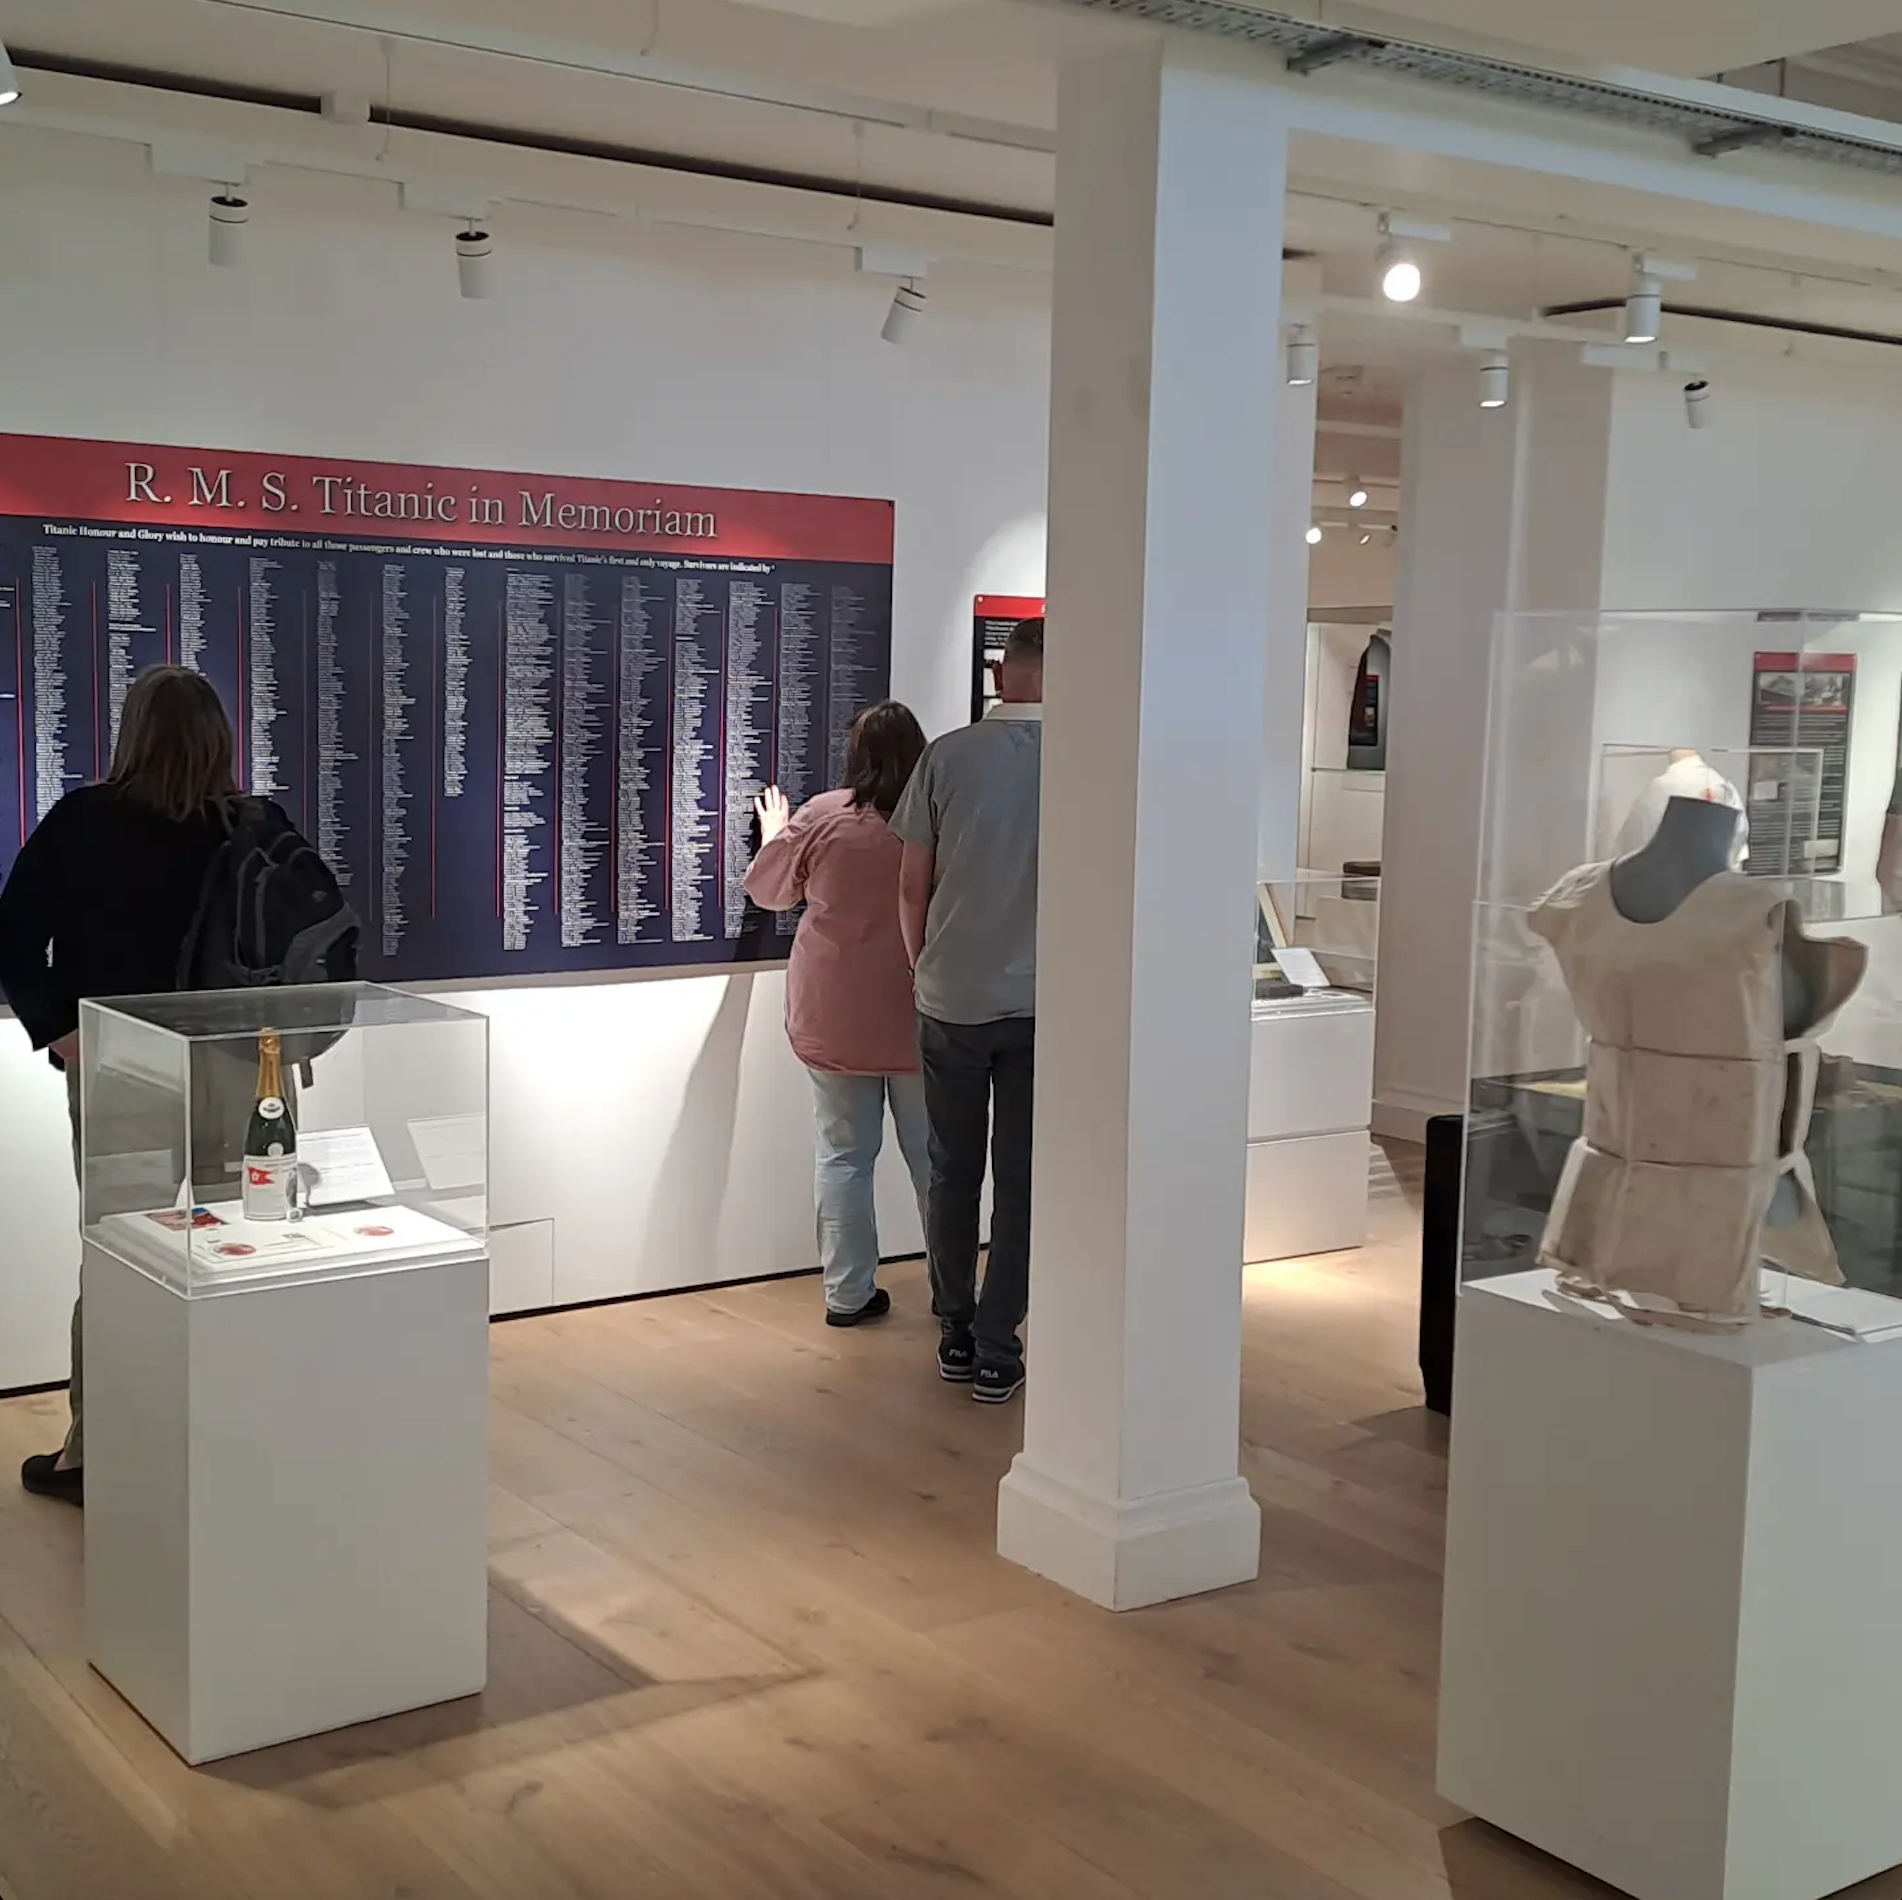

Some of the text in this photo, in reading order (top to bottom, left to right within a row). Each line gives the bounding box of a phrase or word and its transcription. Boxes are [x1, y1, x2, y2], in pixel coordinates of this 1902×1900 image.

[125, 462, 719, 538] R. M. S. Titanic in Memoriam
[43, 524, 78, 536] Titanic
[79, 526, 117, 538] Honour
[118, 529, 136, 539] and
[138, 529, 164, 542] Glory
[166, 531, 187, 541] wish
[188, 532, 198, 542] to
[199, 533, 233, 544] honour
[235, 536, 252, 545] and
[253, 538, 269, 548] pay
[270, 537, 300, 548] tribute
[302, 539, 311, 548] to
[312, 539, 323, 549] all
[325, 540, 348, 550] those
[349, 542, 394, 554] passengers
[395, 545, 411, 554] and
[412, 547, 432, 555] crew
[433, 546, 450, 556] who
[452, 548, 471, 557] were
[472, 547, 487, 557] lost
[488, 549, 503, 559] and
[504, 549, 525, 560] those
[526, 550, 542, 561] who
[544, 552, 575, 562] survived
[625, 557, 639, 566] and
[683, 559, 717, 570] Survivors
[718, 562, 729, 571] are
[730, 560, 761, 572] indicated
[949, 1349, 967, 1358] FILA
[980, 1368, 999, 1379] FILA
